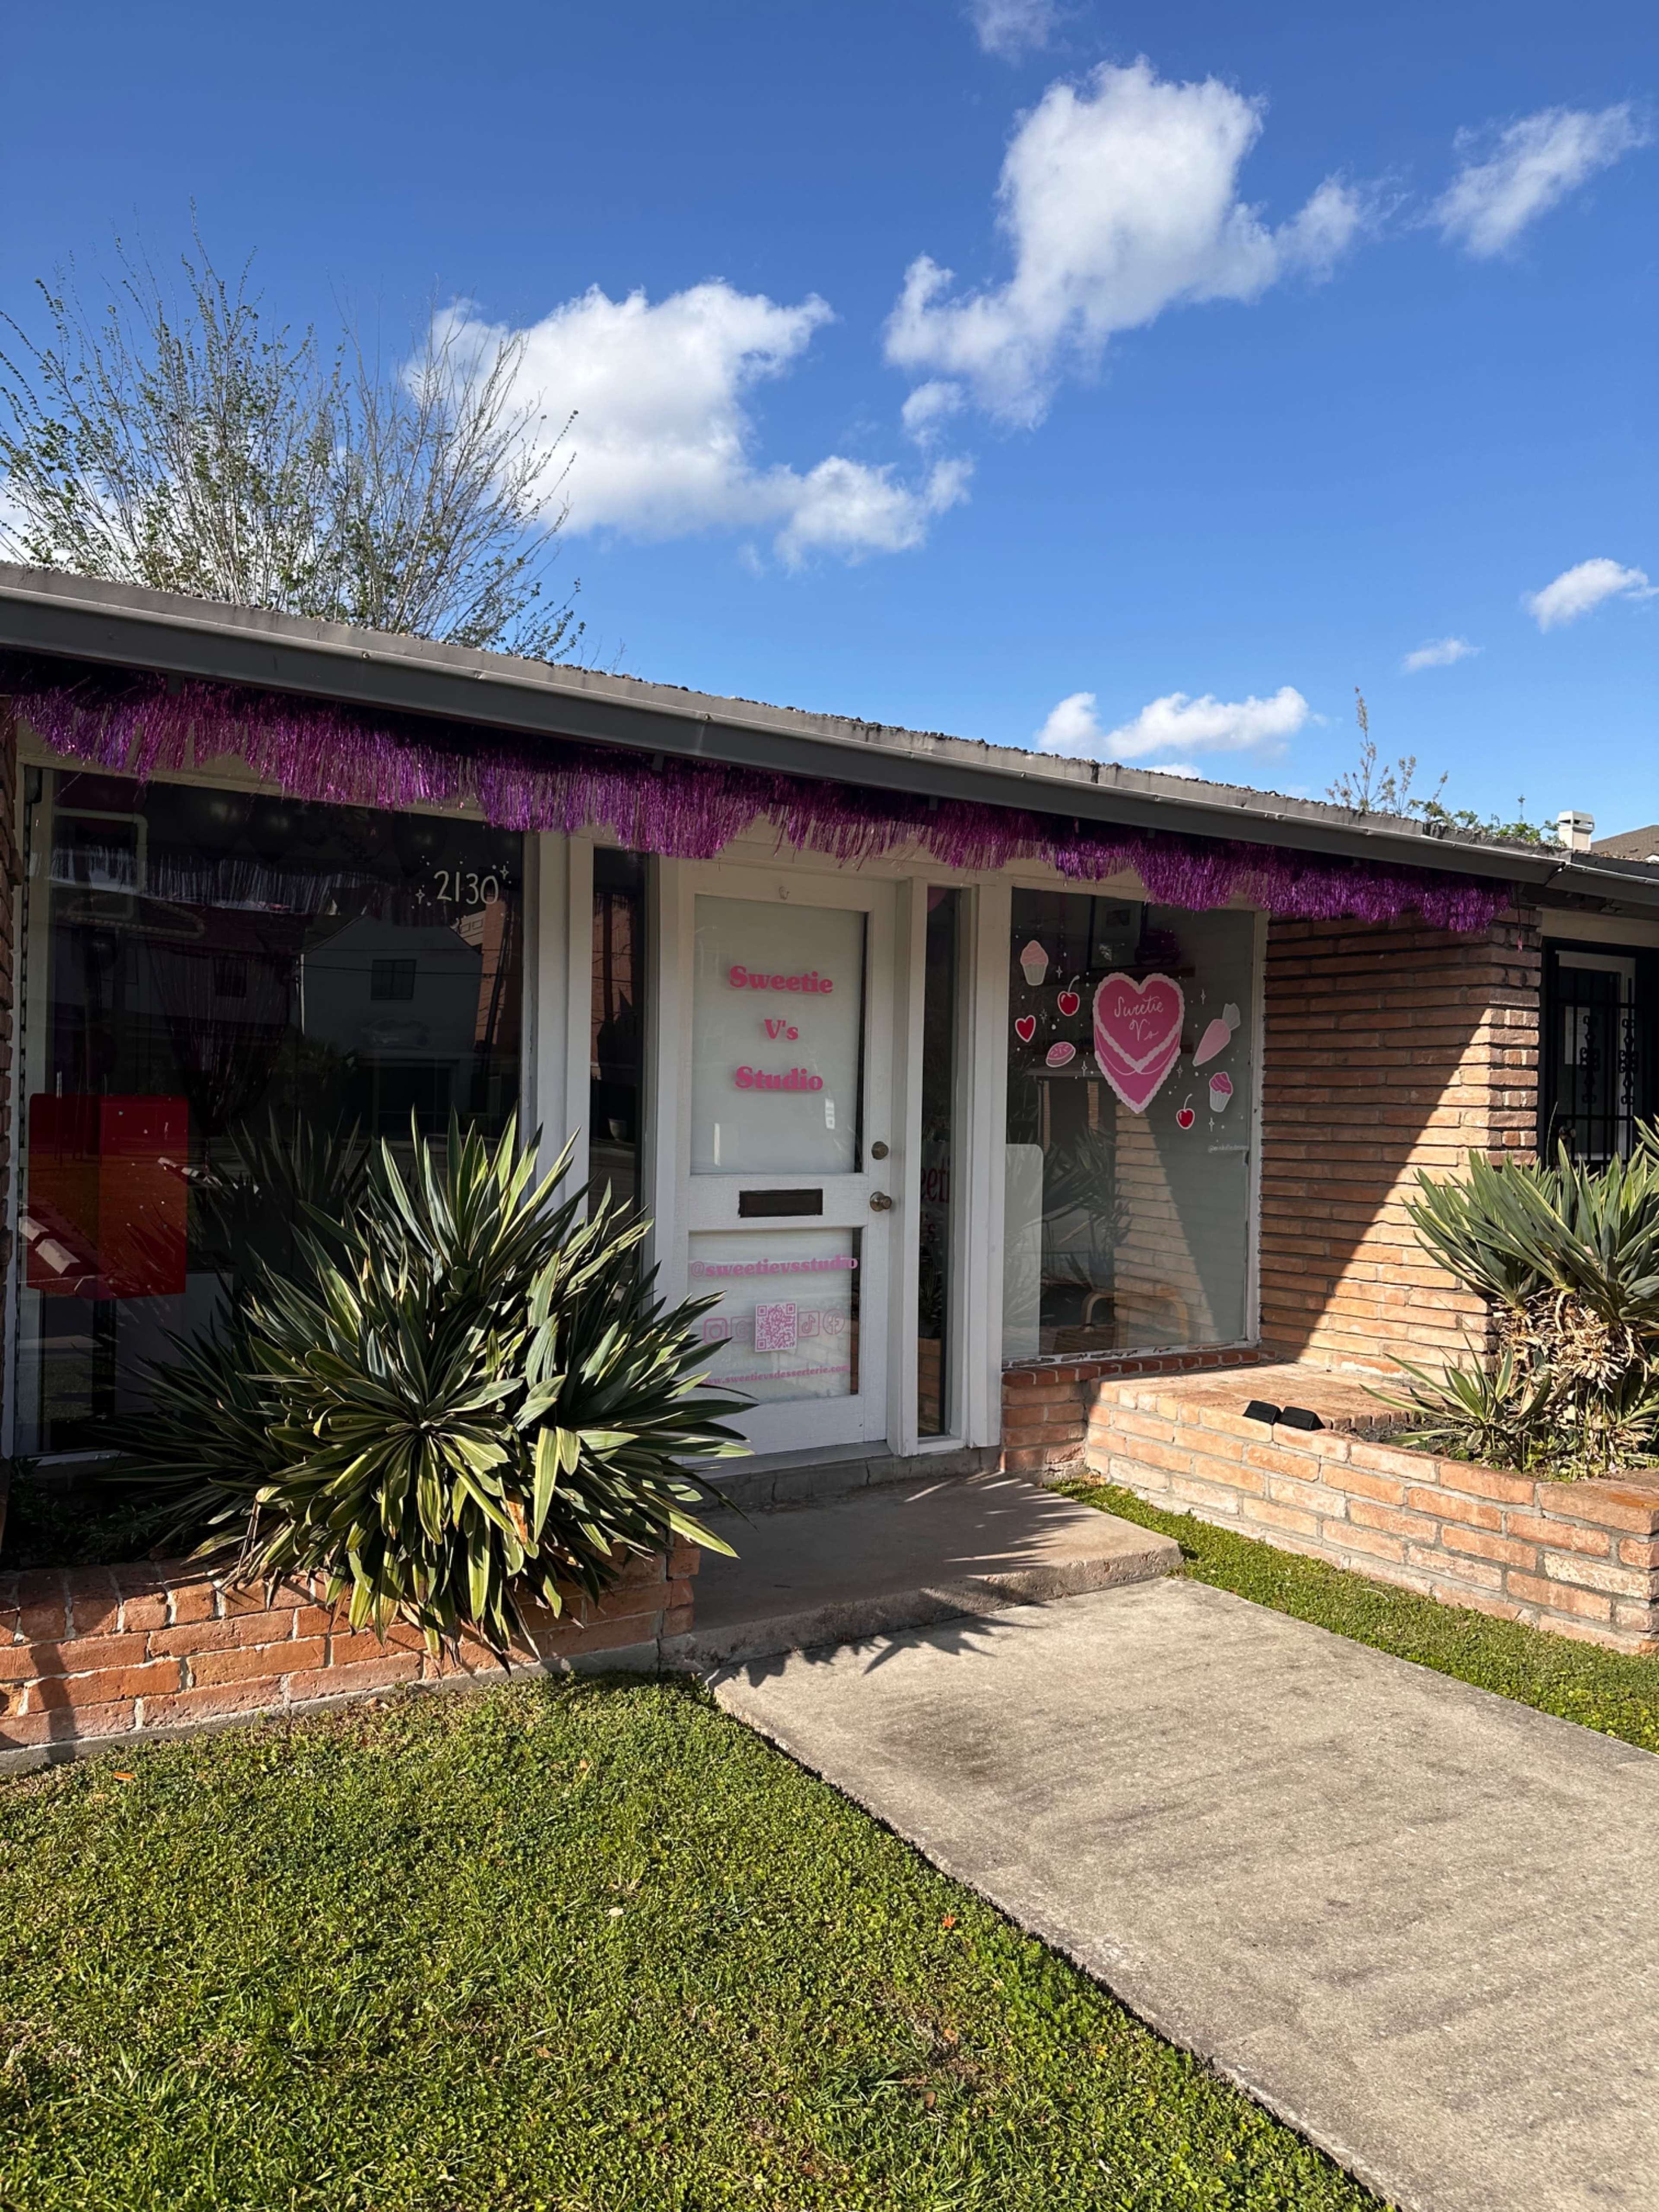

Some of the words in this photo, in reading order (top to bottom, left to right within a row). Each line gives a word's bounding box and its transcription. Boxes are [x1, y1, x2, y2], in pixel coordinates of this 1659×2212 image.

[434, 870, 499, 905] 2130
[730, 966, 833, 993] Sweetie
[1114, 995, 1164, 1017] Sweetie
[764, 1019, 799, 1040] V's
[735, 1066, 823, 1090] Studio
[691, 1254, 858, 1278] @sweetievsstudio
[700, 1364, 851, 1384] ww.sweetievsdesserterie.com
